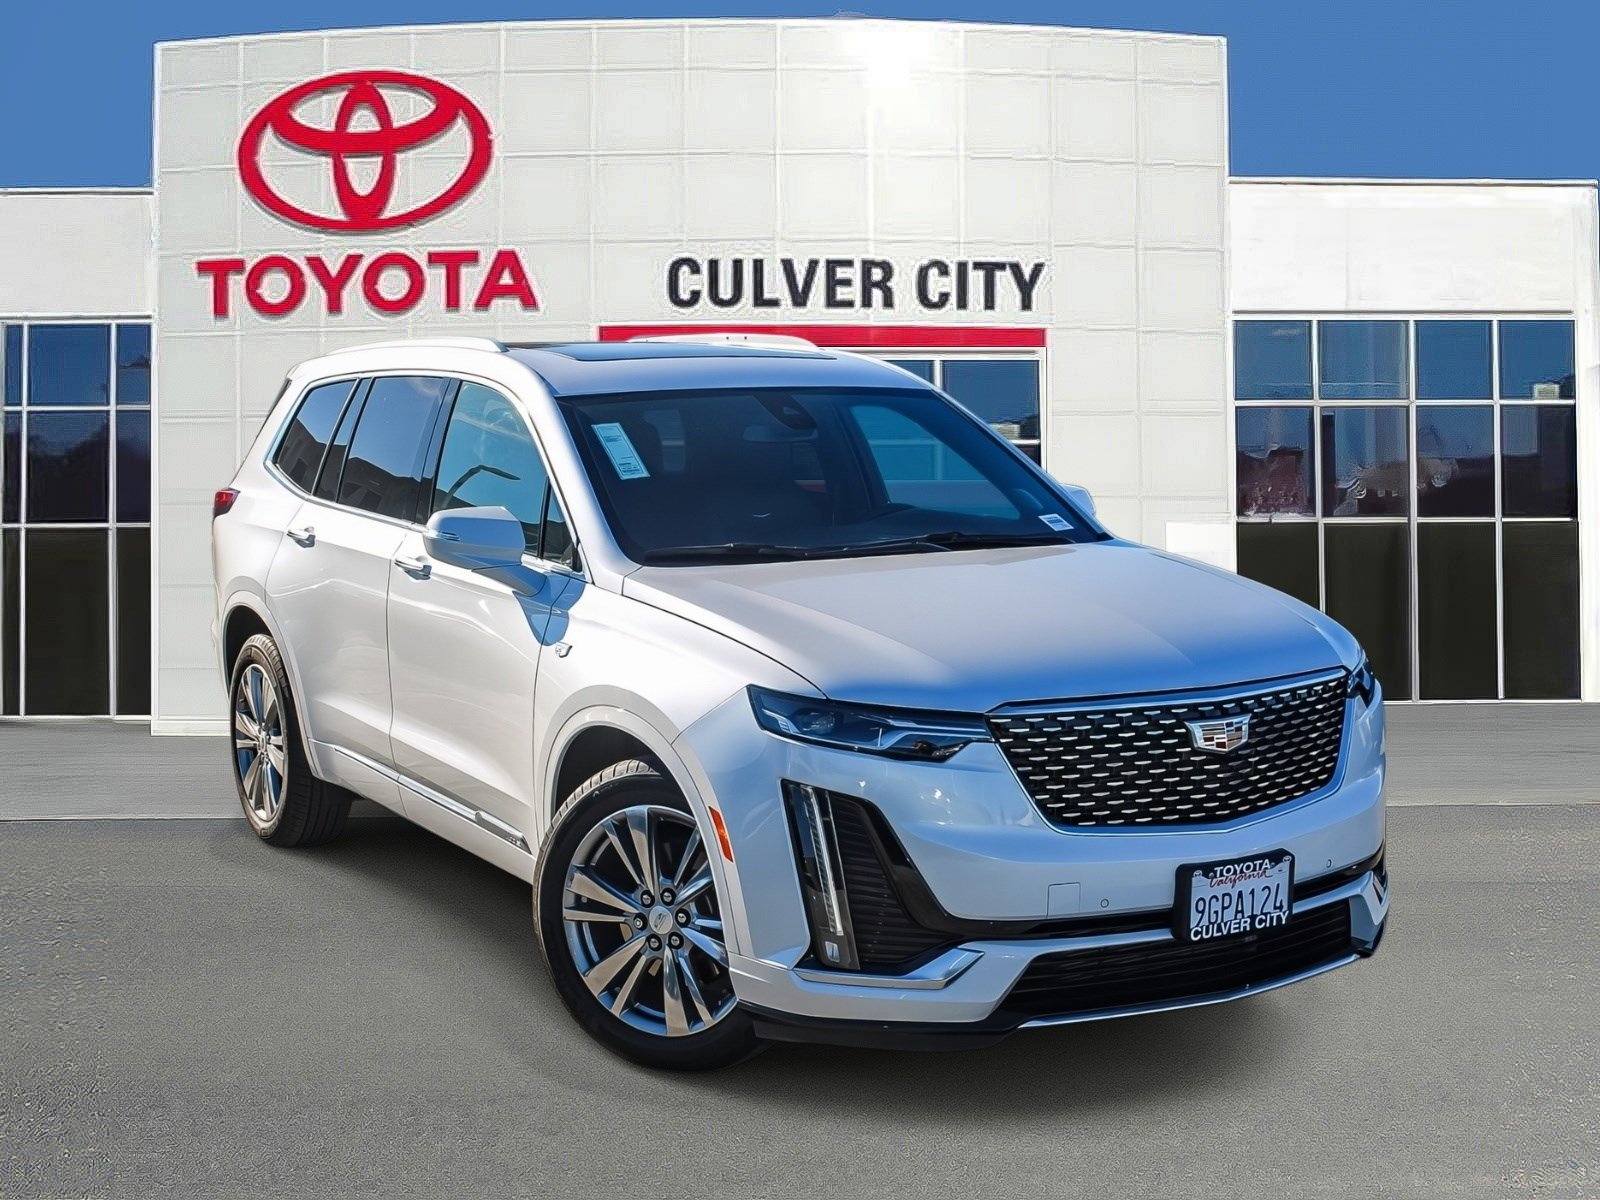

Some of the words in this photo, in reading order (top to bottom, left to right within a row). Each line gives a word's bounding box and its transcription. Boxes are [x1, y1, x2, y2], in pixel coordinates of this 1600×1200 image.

[196, 250, 540, 318] TOYOTA
[667, 257, 895, 308] CULVER
[915, 259, 1045, 311] CITY
[1214, 859, 1271, 878] TOYOTA
[1190, 917, 1251, 941] CULVER
[1254, 910, 1290, 929] CITY
[1194, 882, 1284, 927] 9GPA124
